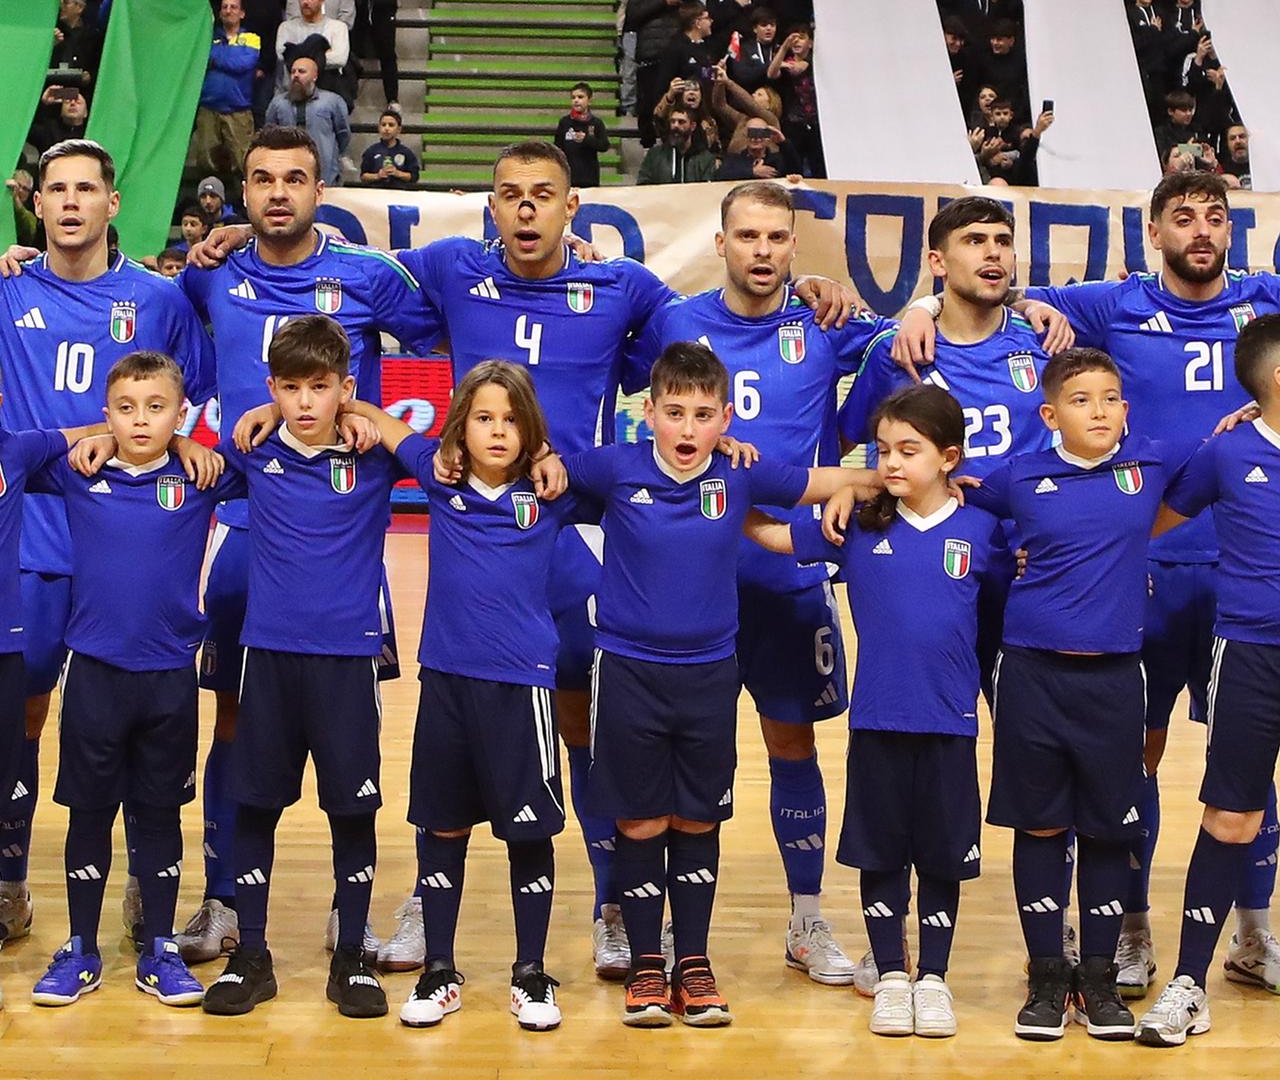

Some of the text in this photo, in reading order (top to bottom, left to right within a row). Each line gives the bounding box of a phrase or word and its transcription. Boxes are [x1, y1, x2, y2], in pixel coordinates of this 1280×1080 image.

[113, 309, 134, 319] ITALIA
[515, 315, 544, 365] 4
[781, 329, 802, 338] ITALIA
[55, 341, 95, 394] 10
[1012, 358, 1031, 368] ITALIA
[1184, 341, 1224, 391] 21
[733, 370, 761, 420] 6
[963, 404, 1013, 458] 23
[702, 483, 723, 492] ITALIA
[513, 495, 534, 504] ITALIA
[947, 542, 968, 552] ITALIA
[813, 625, 836, 677] 6
[780, 806, 824, 820] ITALIA
[349, 975, 379, 989] PUMA
